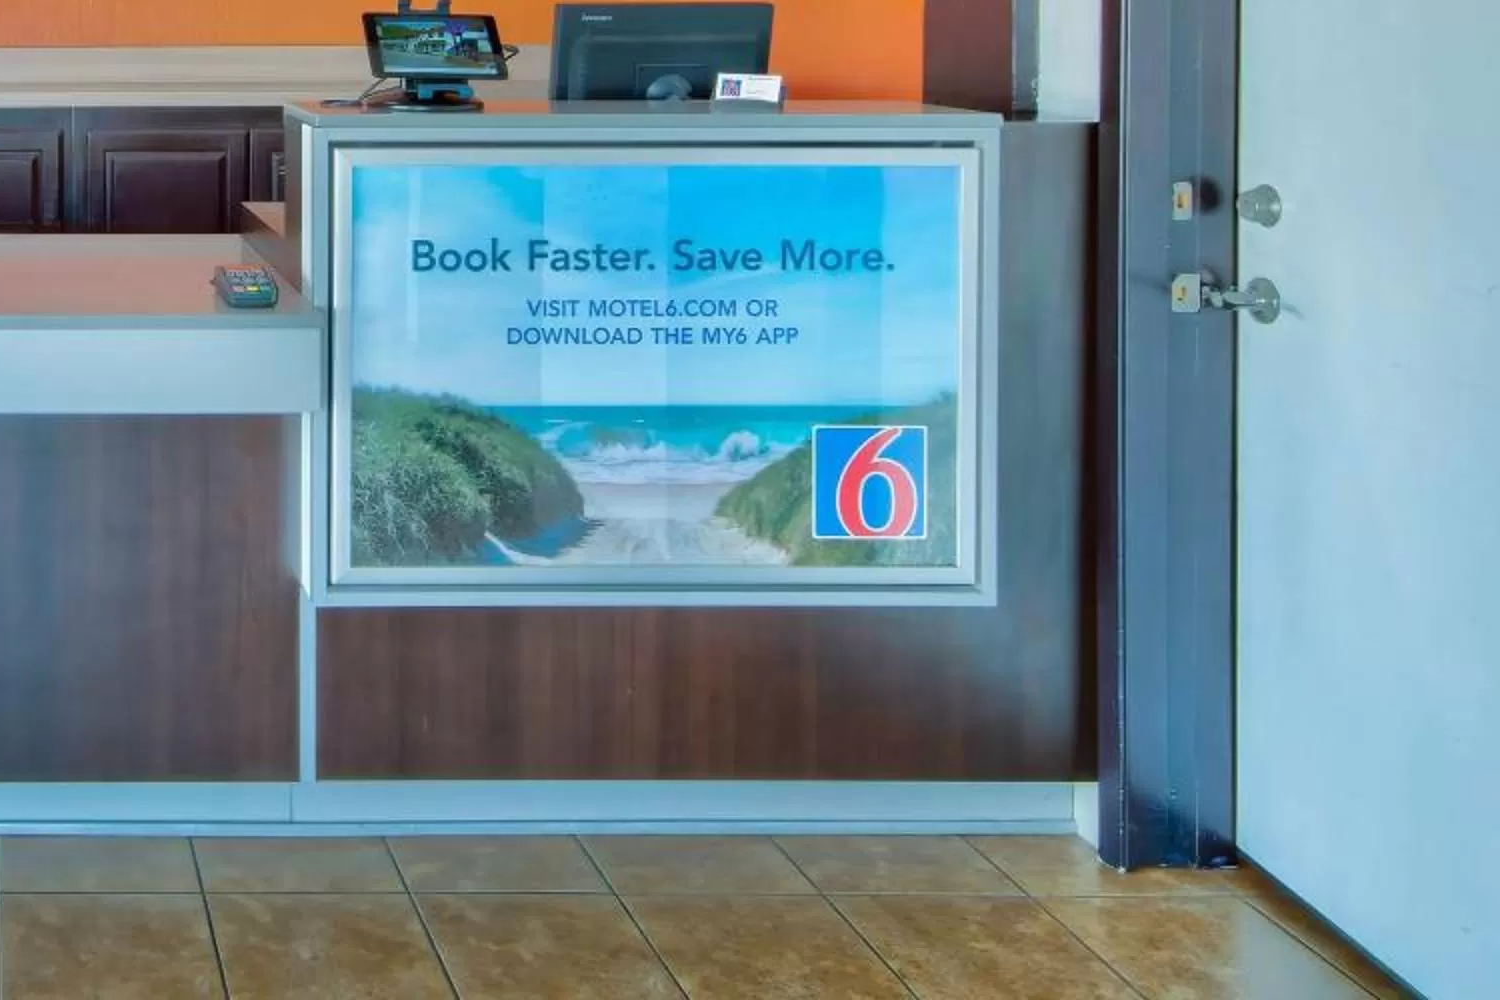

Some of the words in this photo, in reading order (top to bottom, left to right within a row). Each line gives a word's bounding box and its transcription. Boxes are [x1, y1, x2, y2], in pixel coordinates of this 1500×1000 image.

[412, 238, 510, 272] Book
[527, 239, 656, 272] Faster.
[673, 239, 763, 272] Save
[780, 240, 896, 272] More.
[526, 300, 580, 317] VISIT
[589, 300, 738, 318] MOTEL6.COM
[745, 300, 779, 317] OR
[507, 327, 643, 345] DOWNLOAD
[650, 327, 694, 345] THE
[702, 327, 747, 345] MY6
[755, 327, 799, 345] APP
[836, 426, 918, 539] 6
